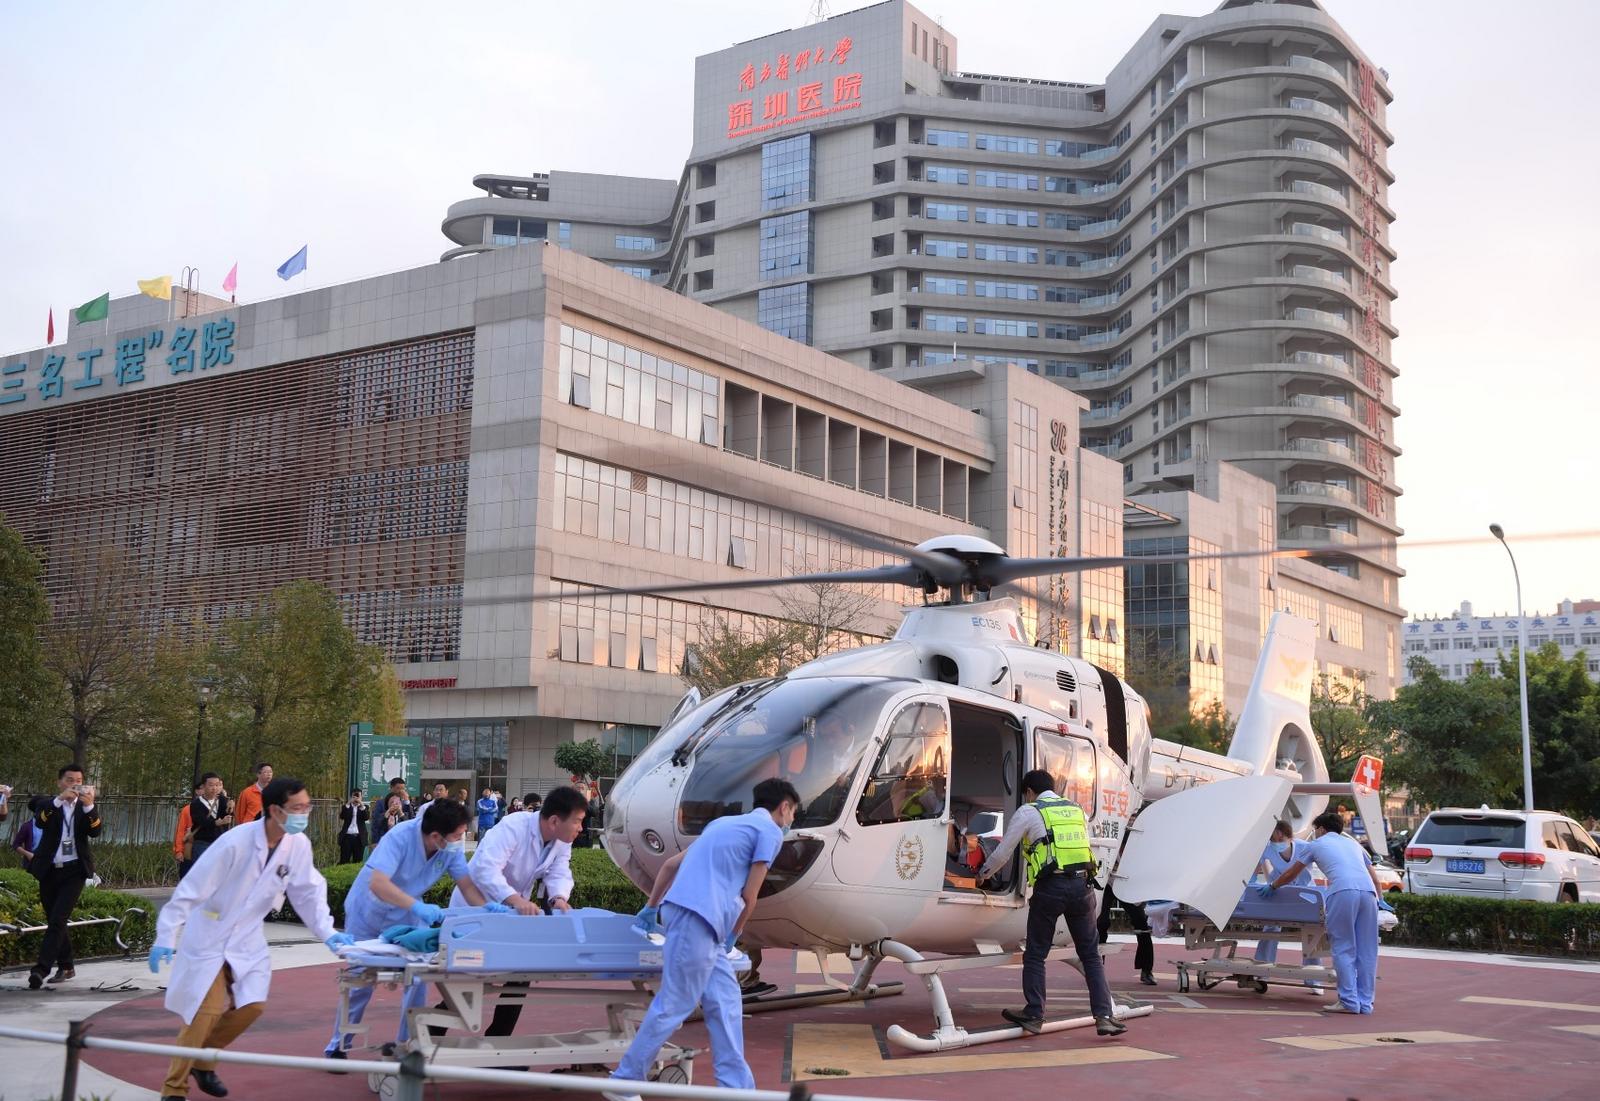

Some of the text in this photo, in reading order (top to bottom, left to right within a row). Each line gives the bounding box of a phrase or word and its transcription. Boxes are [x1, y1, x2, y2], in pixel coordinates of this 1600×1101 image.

[727, 72, 864, 130] 深圳医院
[971, 616, 1002, 630] EC135
